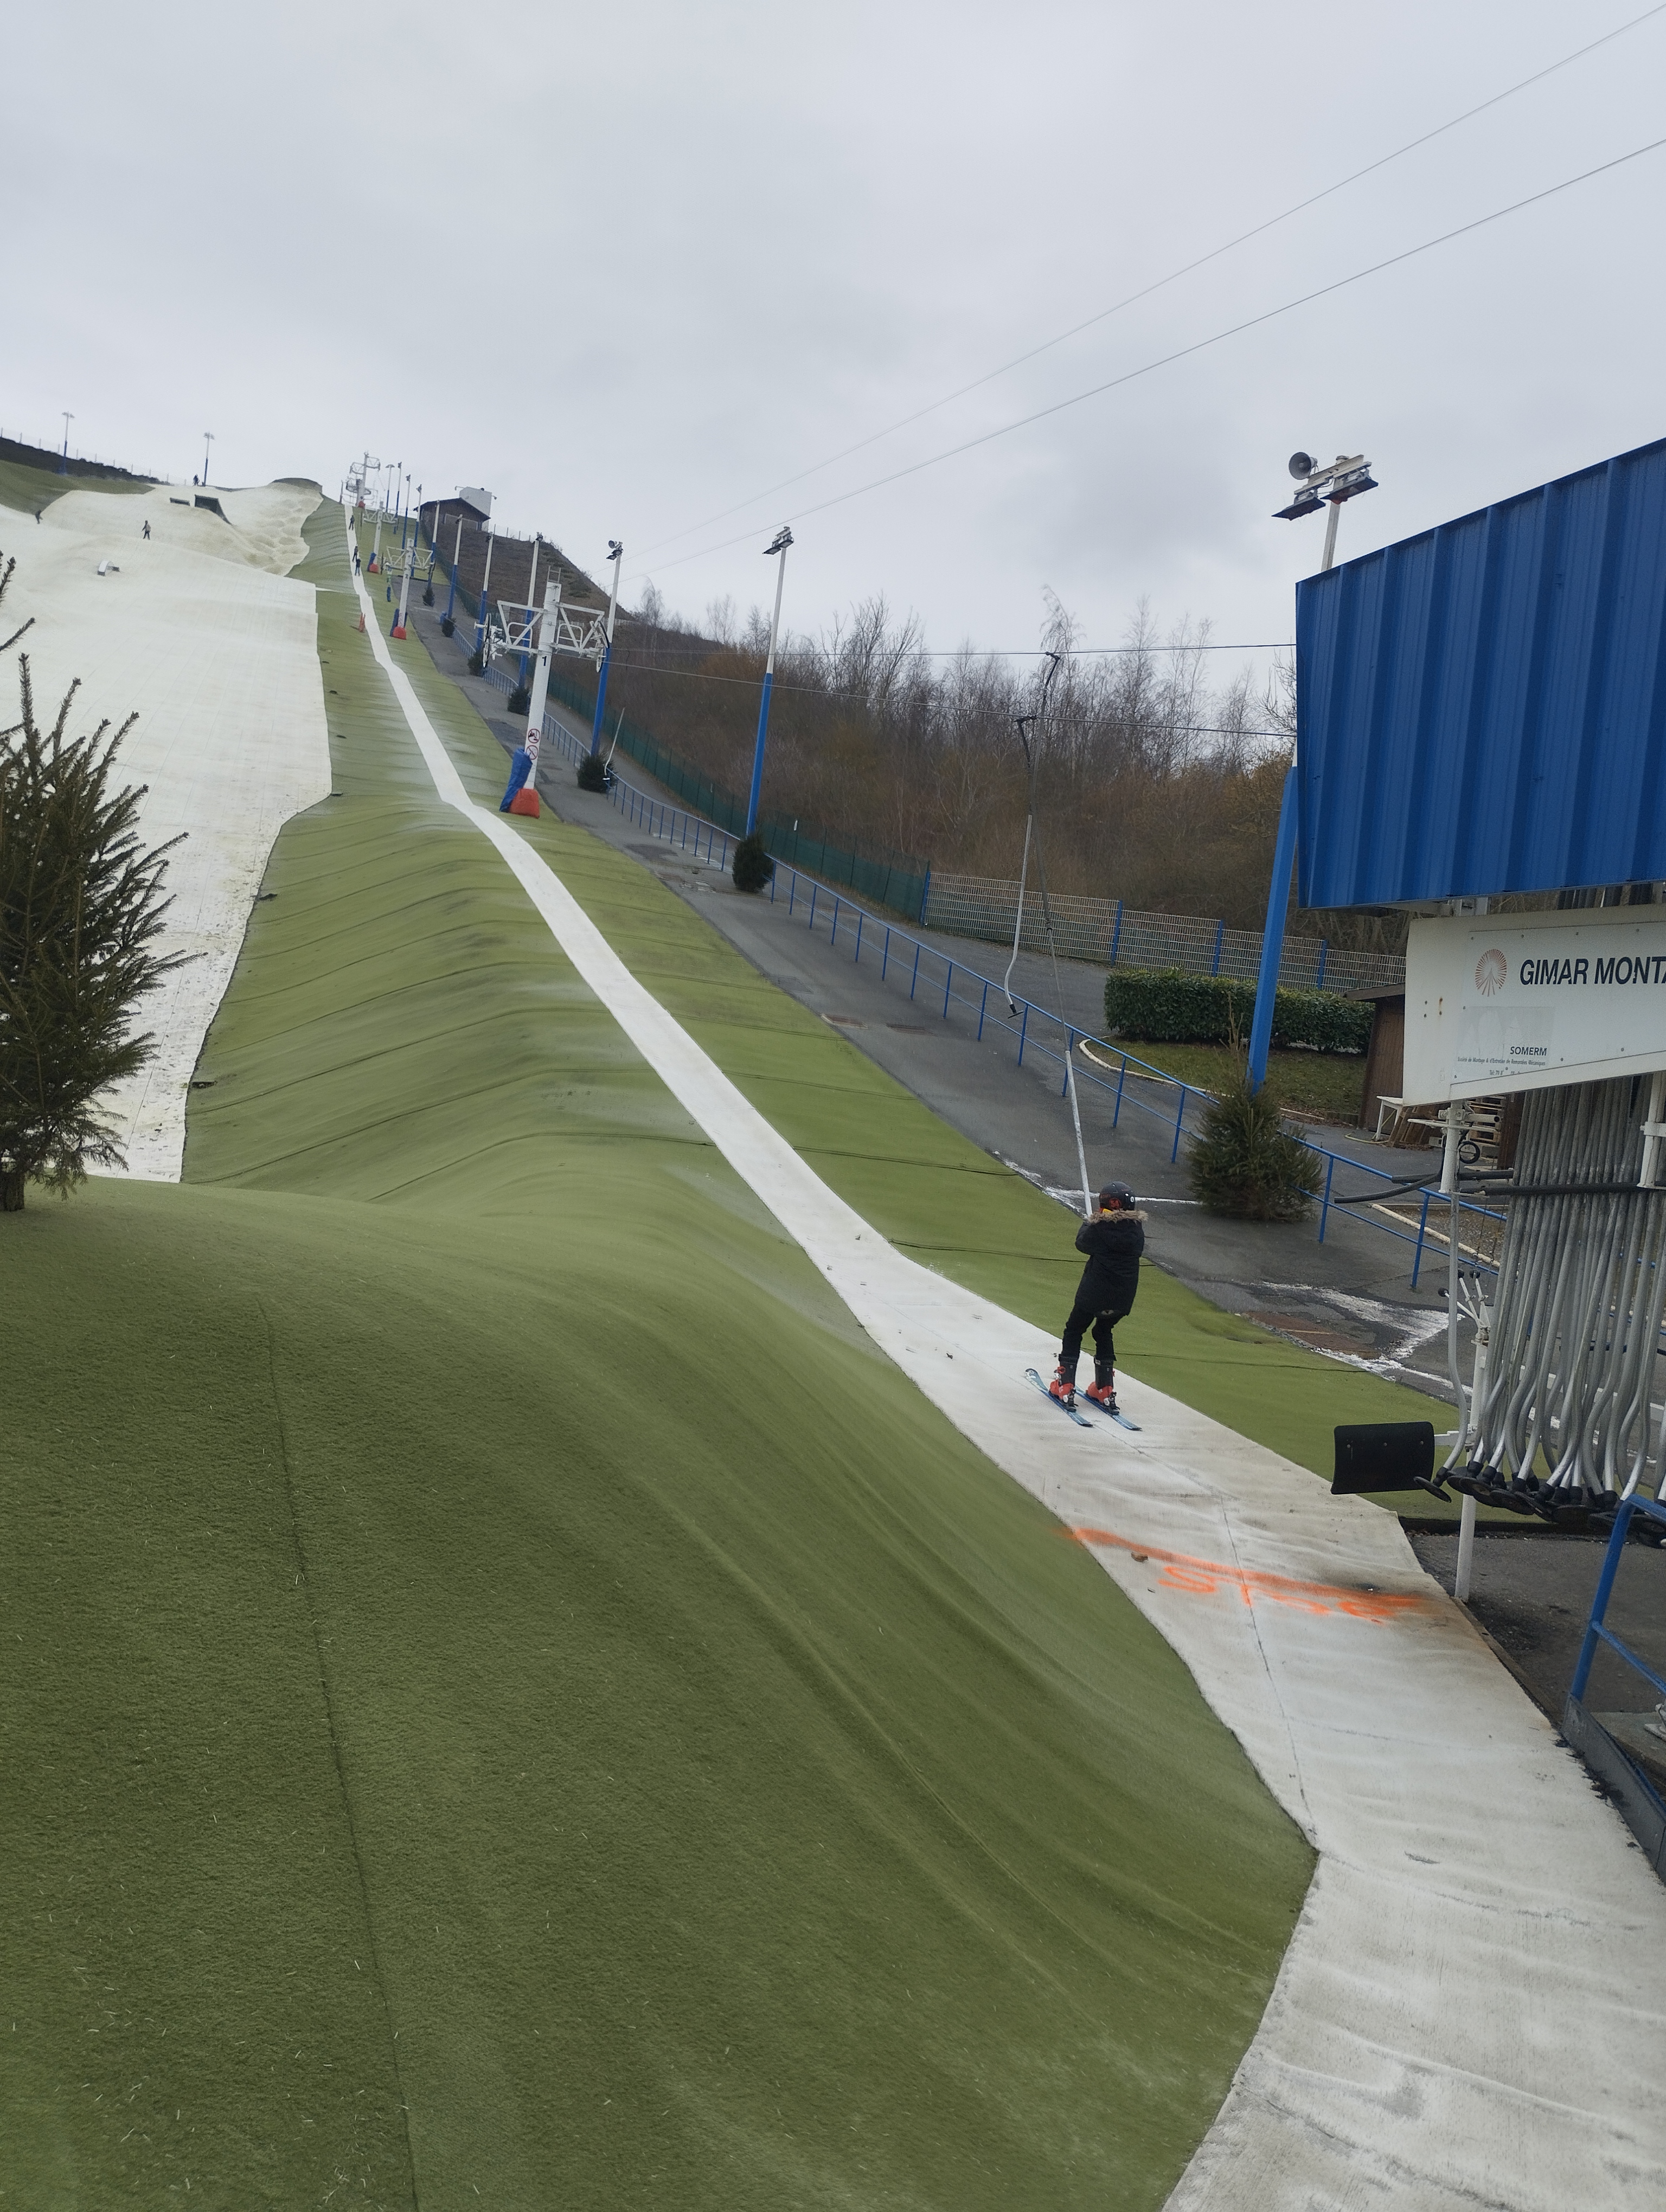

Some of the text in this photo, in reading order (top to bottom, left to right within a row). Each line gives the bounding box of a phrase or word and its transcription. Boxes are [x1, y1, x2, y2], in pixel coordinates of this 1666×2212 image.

[542, 655, 547, 666] 1
[1520, 958, 1590, 985] GIMAR
[1509, 1046, 1547, 1056] SOMERM
